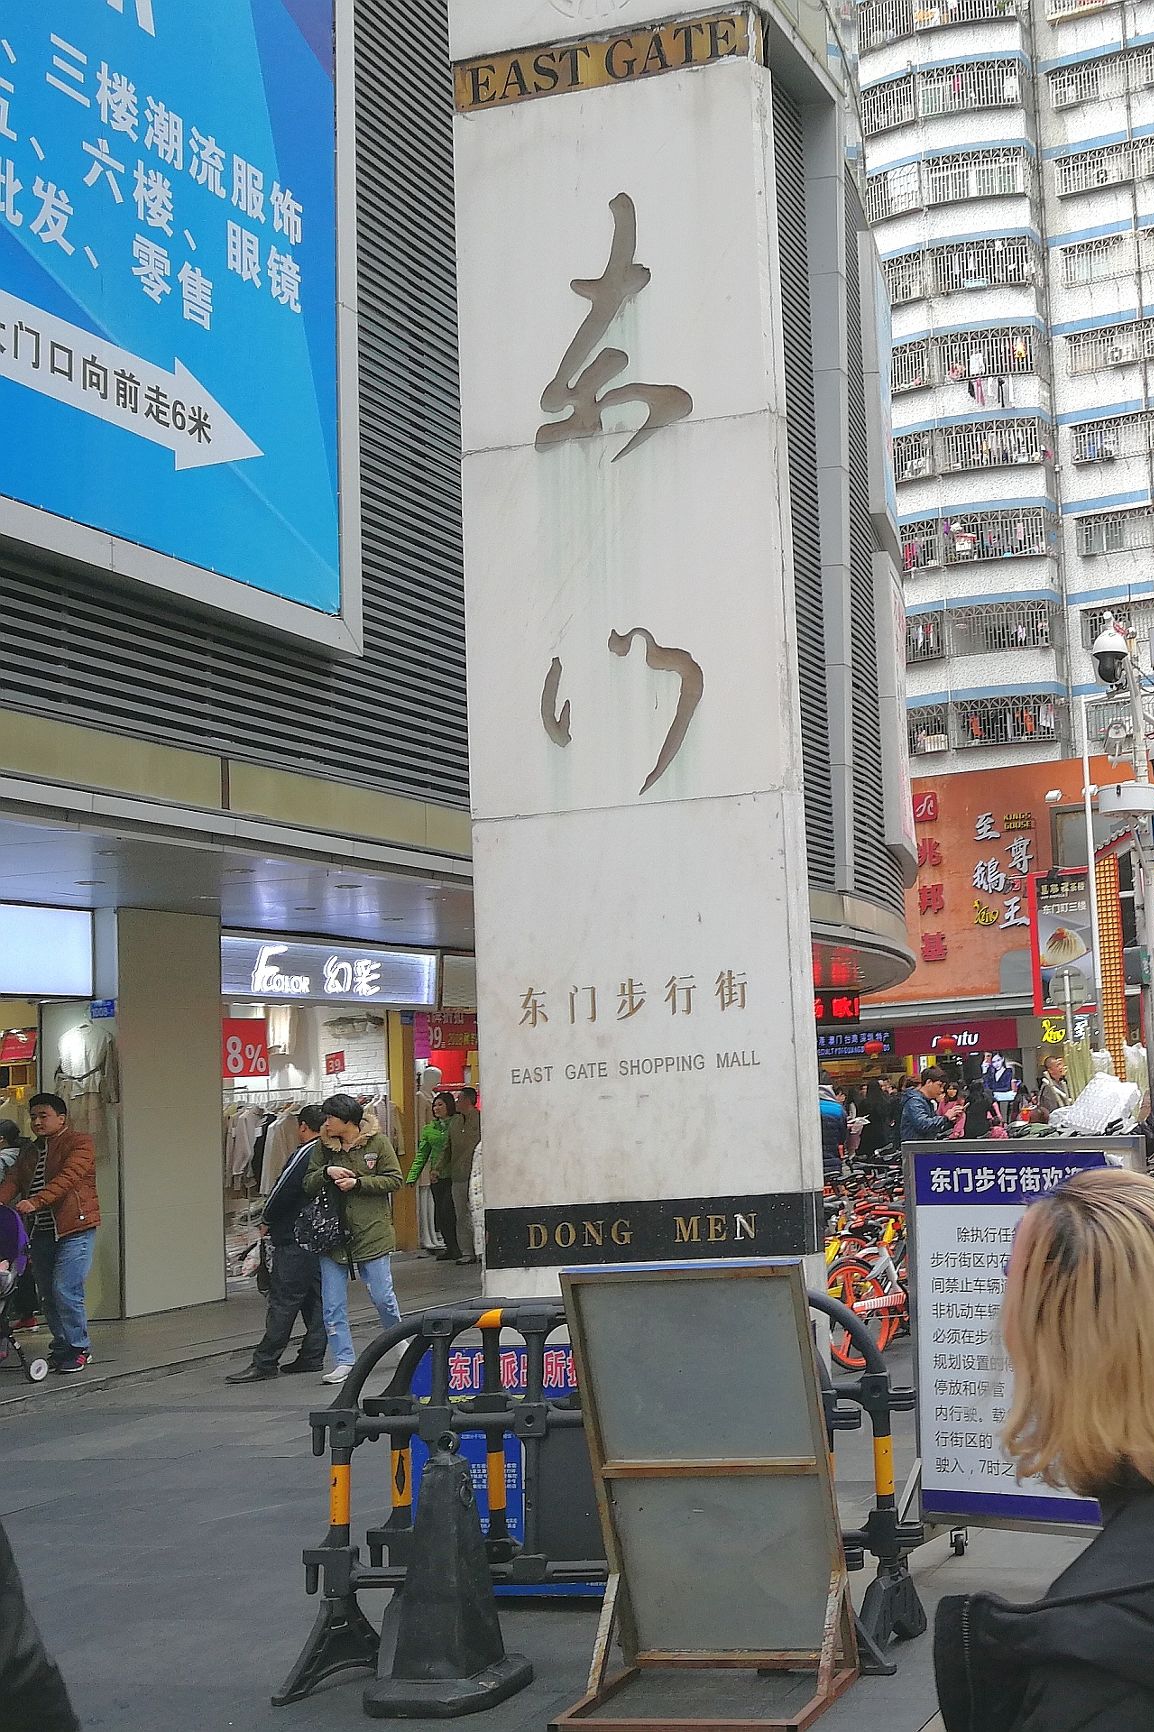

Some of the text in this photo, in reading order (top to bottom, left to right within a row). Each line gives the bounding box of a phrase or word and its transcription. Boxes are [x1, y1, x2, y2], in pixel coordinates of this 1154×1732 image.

[467, 17, 738, 106] EAST GATE
[0, 322, 213, 446] 门口向前走6米
[917, 837, 948, 962] 兆邦基
[518, 969, 748, 1028] 东门步行街
[511, 1050, 761, 1085] EAST GATE SHOPPING MALL
[931, 1030, 979, 1049] itu
[526, 1211, 758, 1250] DONG MEN
